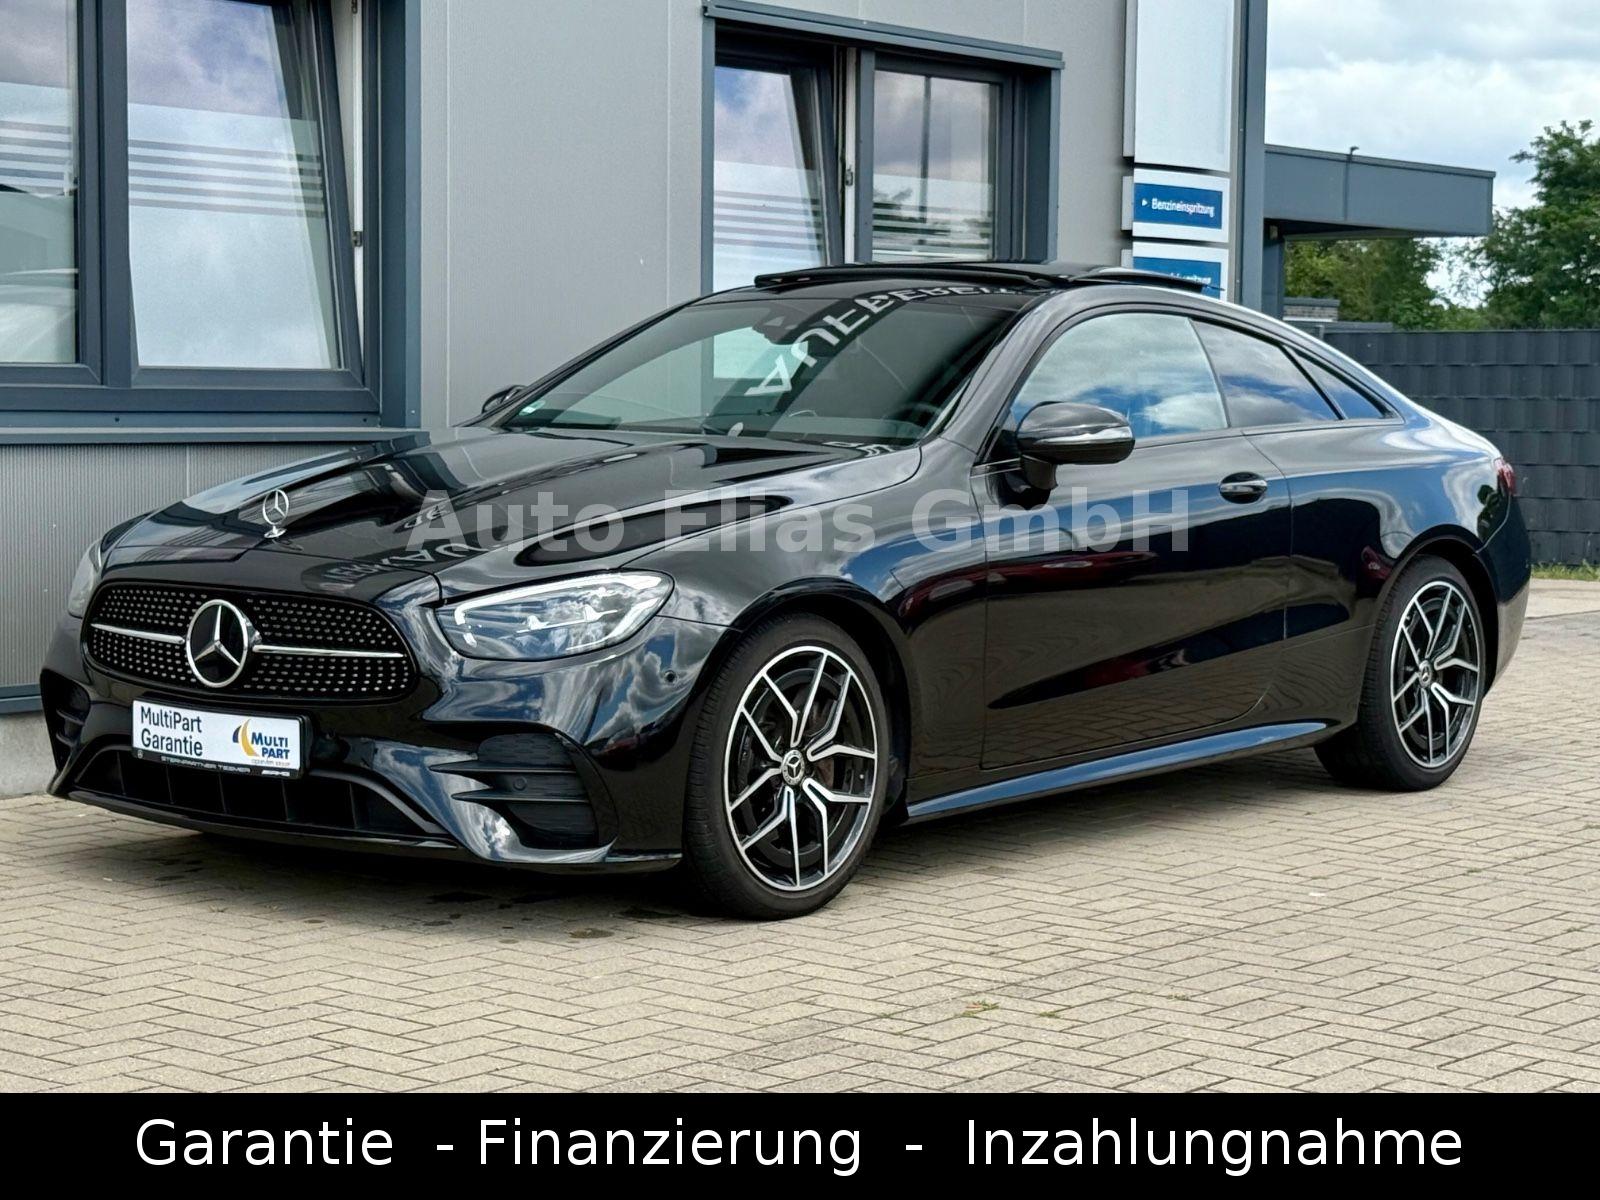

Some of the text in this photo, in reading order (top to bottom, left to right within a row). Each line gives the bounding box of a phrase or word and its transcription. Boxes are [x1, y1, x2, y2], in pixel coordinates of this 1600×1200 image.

[1151, 197, 1215, 218] Benzineinspritzung
[140, 706, 203, 733] MultiPart
[140, 728, 203, 757] Garantie
[251, 732, 289, 748] MULTI
[261, 747, 291, 760] PART
